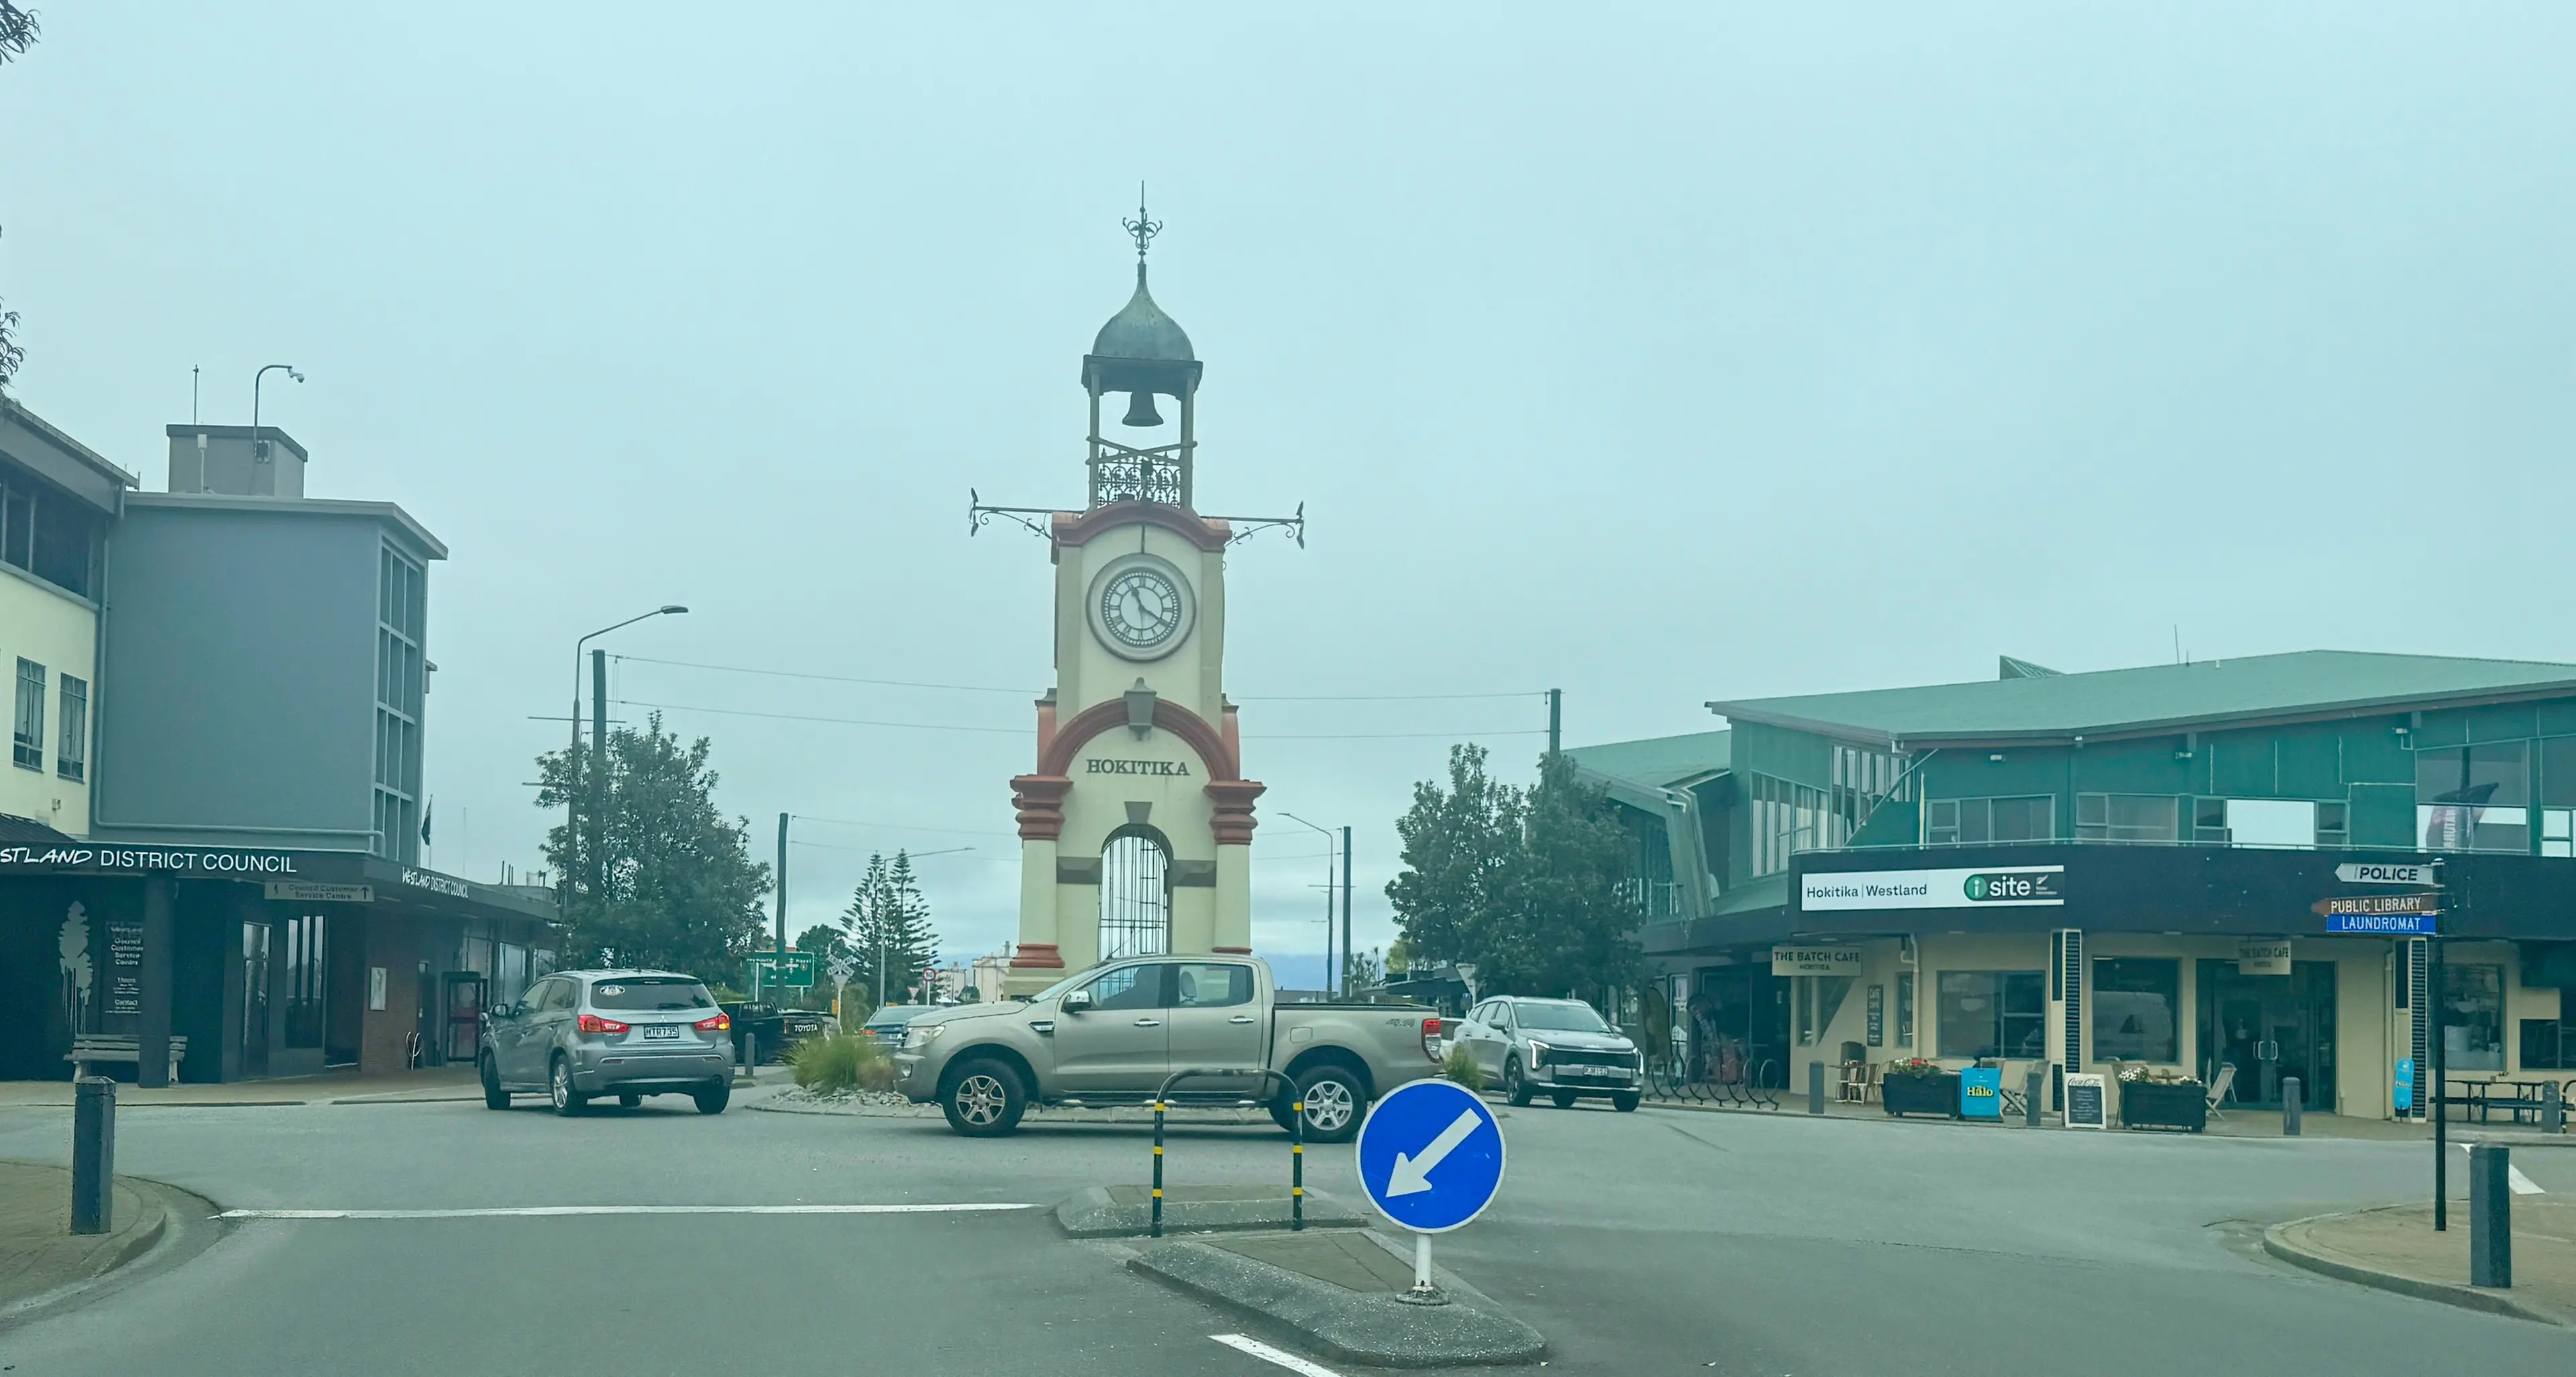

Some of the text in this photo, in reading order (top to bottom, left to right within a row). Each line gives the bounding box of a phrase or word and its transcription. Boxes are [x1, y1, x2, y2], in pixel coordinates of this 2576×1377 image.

[1085, 759, 1191, 776] HOKITIKA
[101, 850, 197, 869] DISTRICT
[203, 854, 297, 873] COUNCIL
[2359, 867, 2418, 881] POLICE
[1807, 883, 1927, 898] Hokitika Westland
[2331, 897, 2421, 914] PUBLIC LIBRARY
[2342, 916, 2421, 930] LAUNDROMAT
[1774, 952, 1860, 962] THE BATCH CAFE
